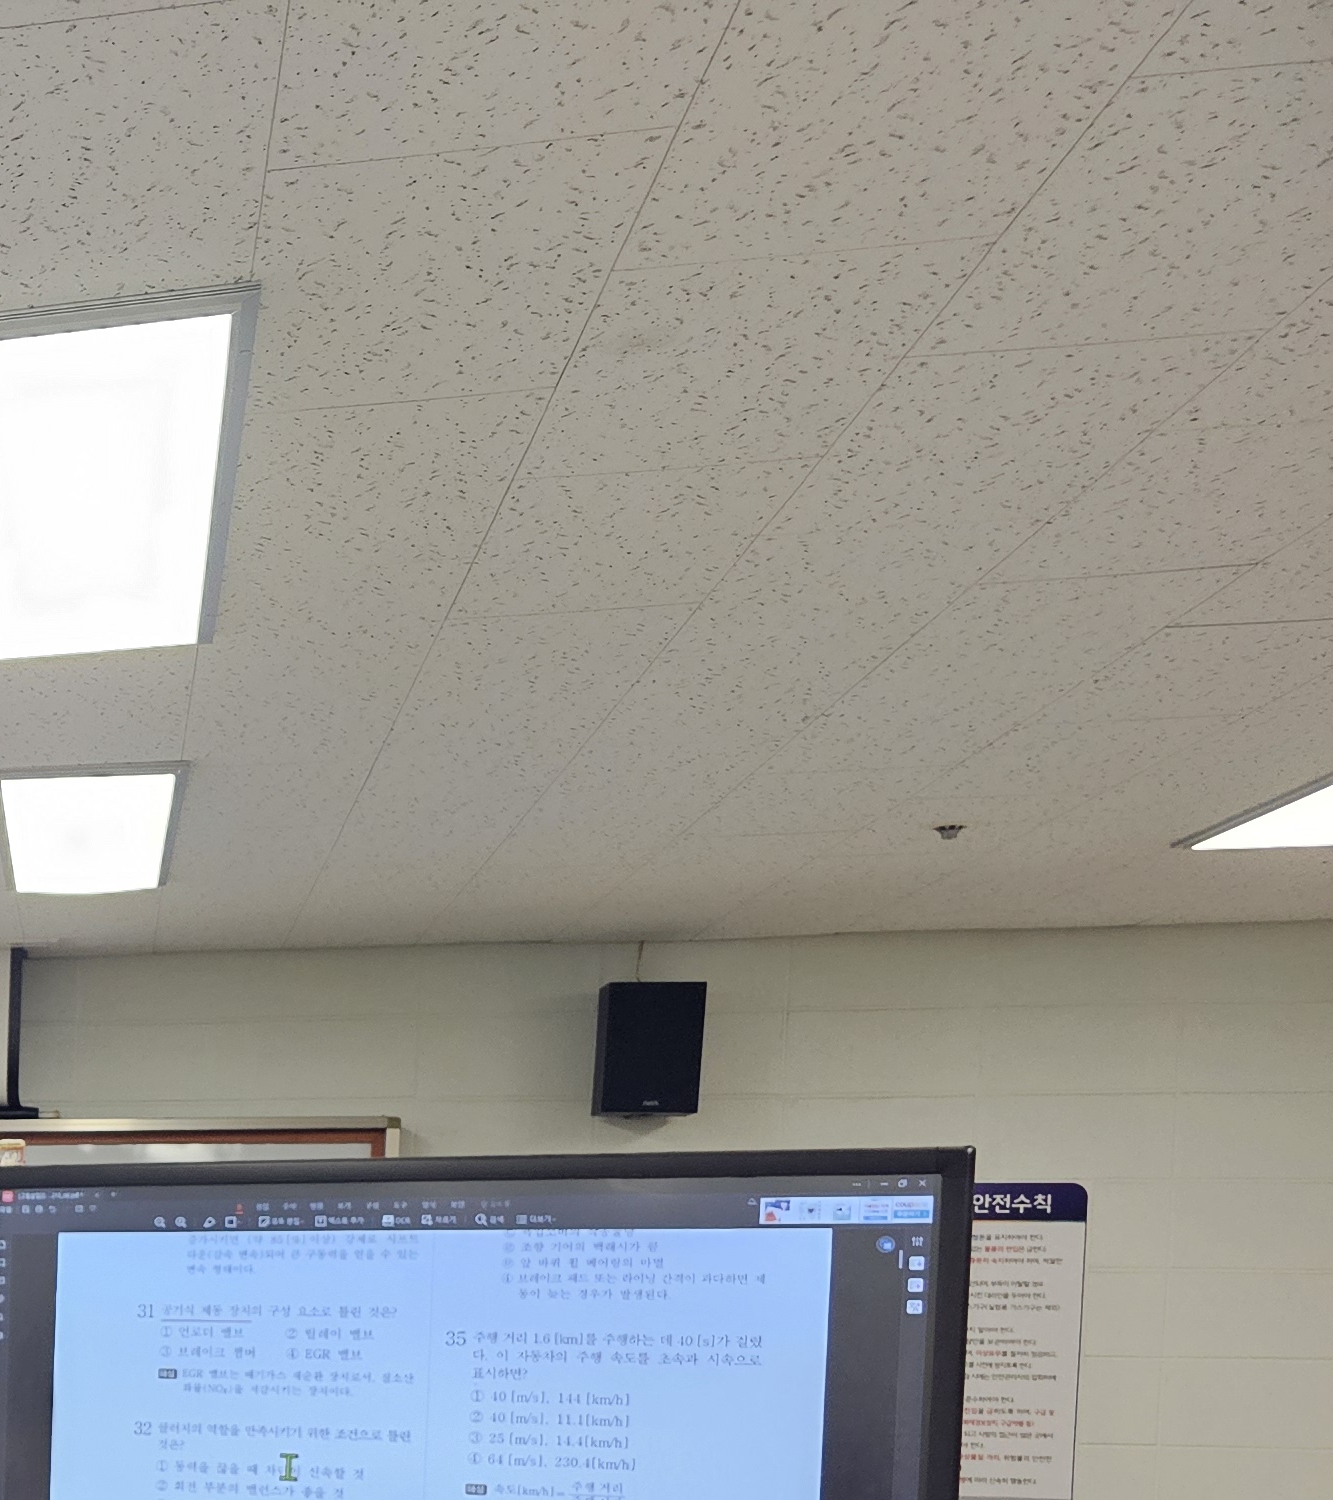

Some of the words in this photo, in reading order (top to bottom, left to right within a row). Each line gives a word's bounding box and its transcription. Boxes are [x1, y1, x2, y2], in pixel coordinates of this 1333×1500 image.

[972, 1193, 1053, 1214] 안전수칙
[137, 1303, 155, 1318] 31
[445, 1330, 467, 1347] 35
[304, 1348, 331, 1360] EGR
[516, 1351, 568, 1364] 자동차의
[575, 1351, 602, 1364] 주행
[610, 1352, 649, 1365] 속도를
[658, 1352, 699, 1366] 초속과
[707, 1353, 762, 1367] 시속으로
[134, 1421, 152, 1435] 32
